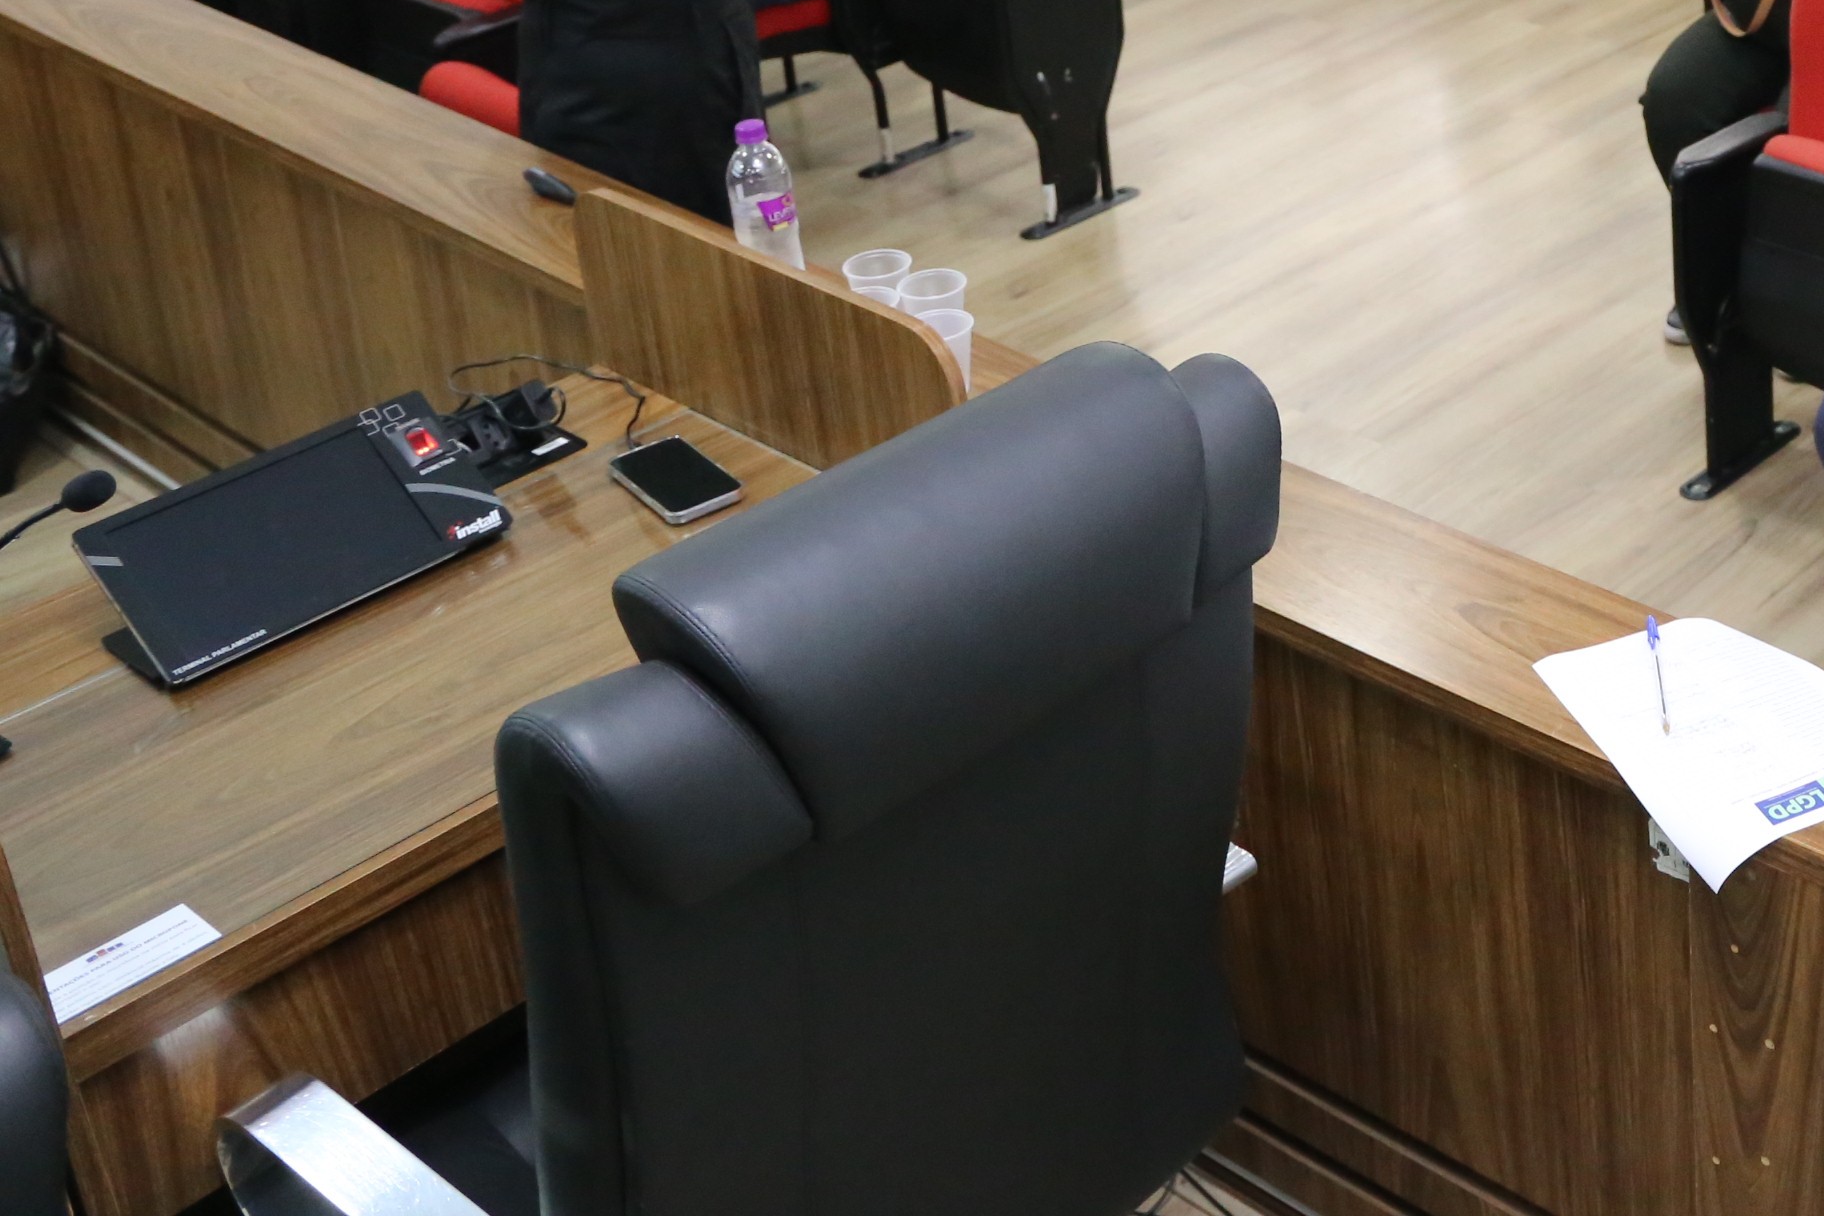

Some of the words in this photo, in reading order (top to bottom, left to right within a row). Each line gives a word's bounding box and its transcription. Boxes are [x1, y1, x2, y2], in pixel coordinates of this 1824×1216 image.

[455, 509, 501, 539] install
[172, 655, 212, 675] TERMINAL
[211, 629, 267, 657] PARLAMENTAR
